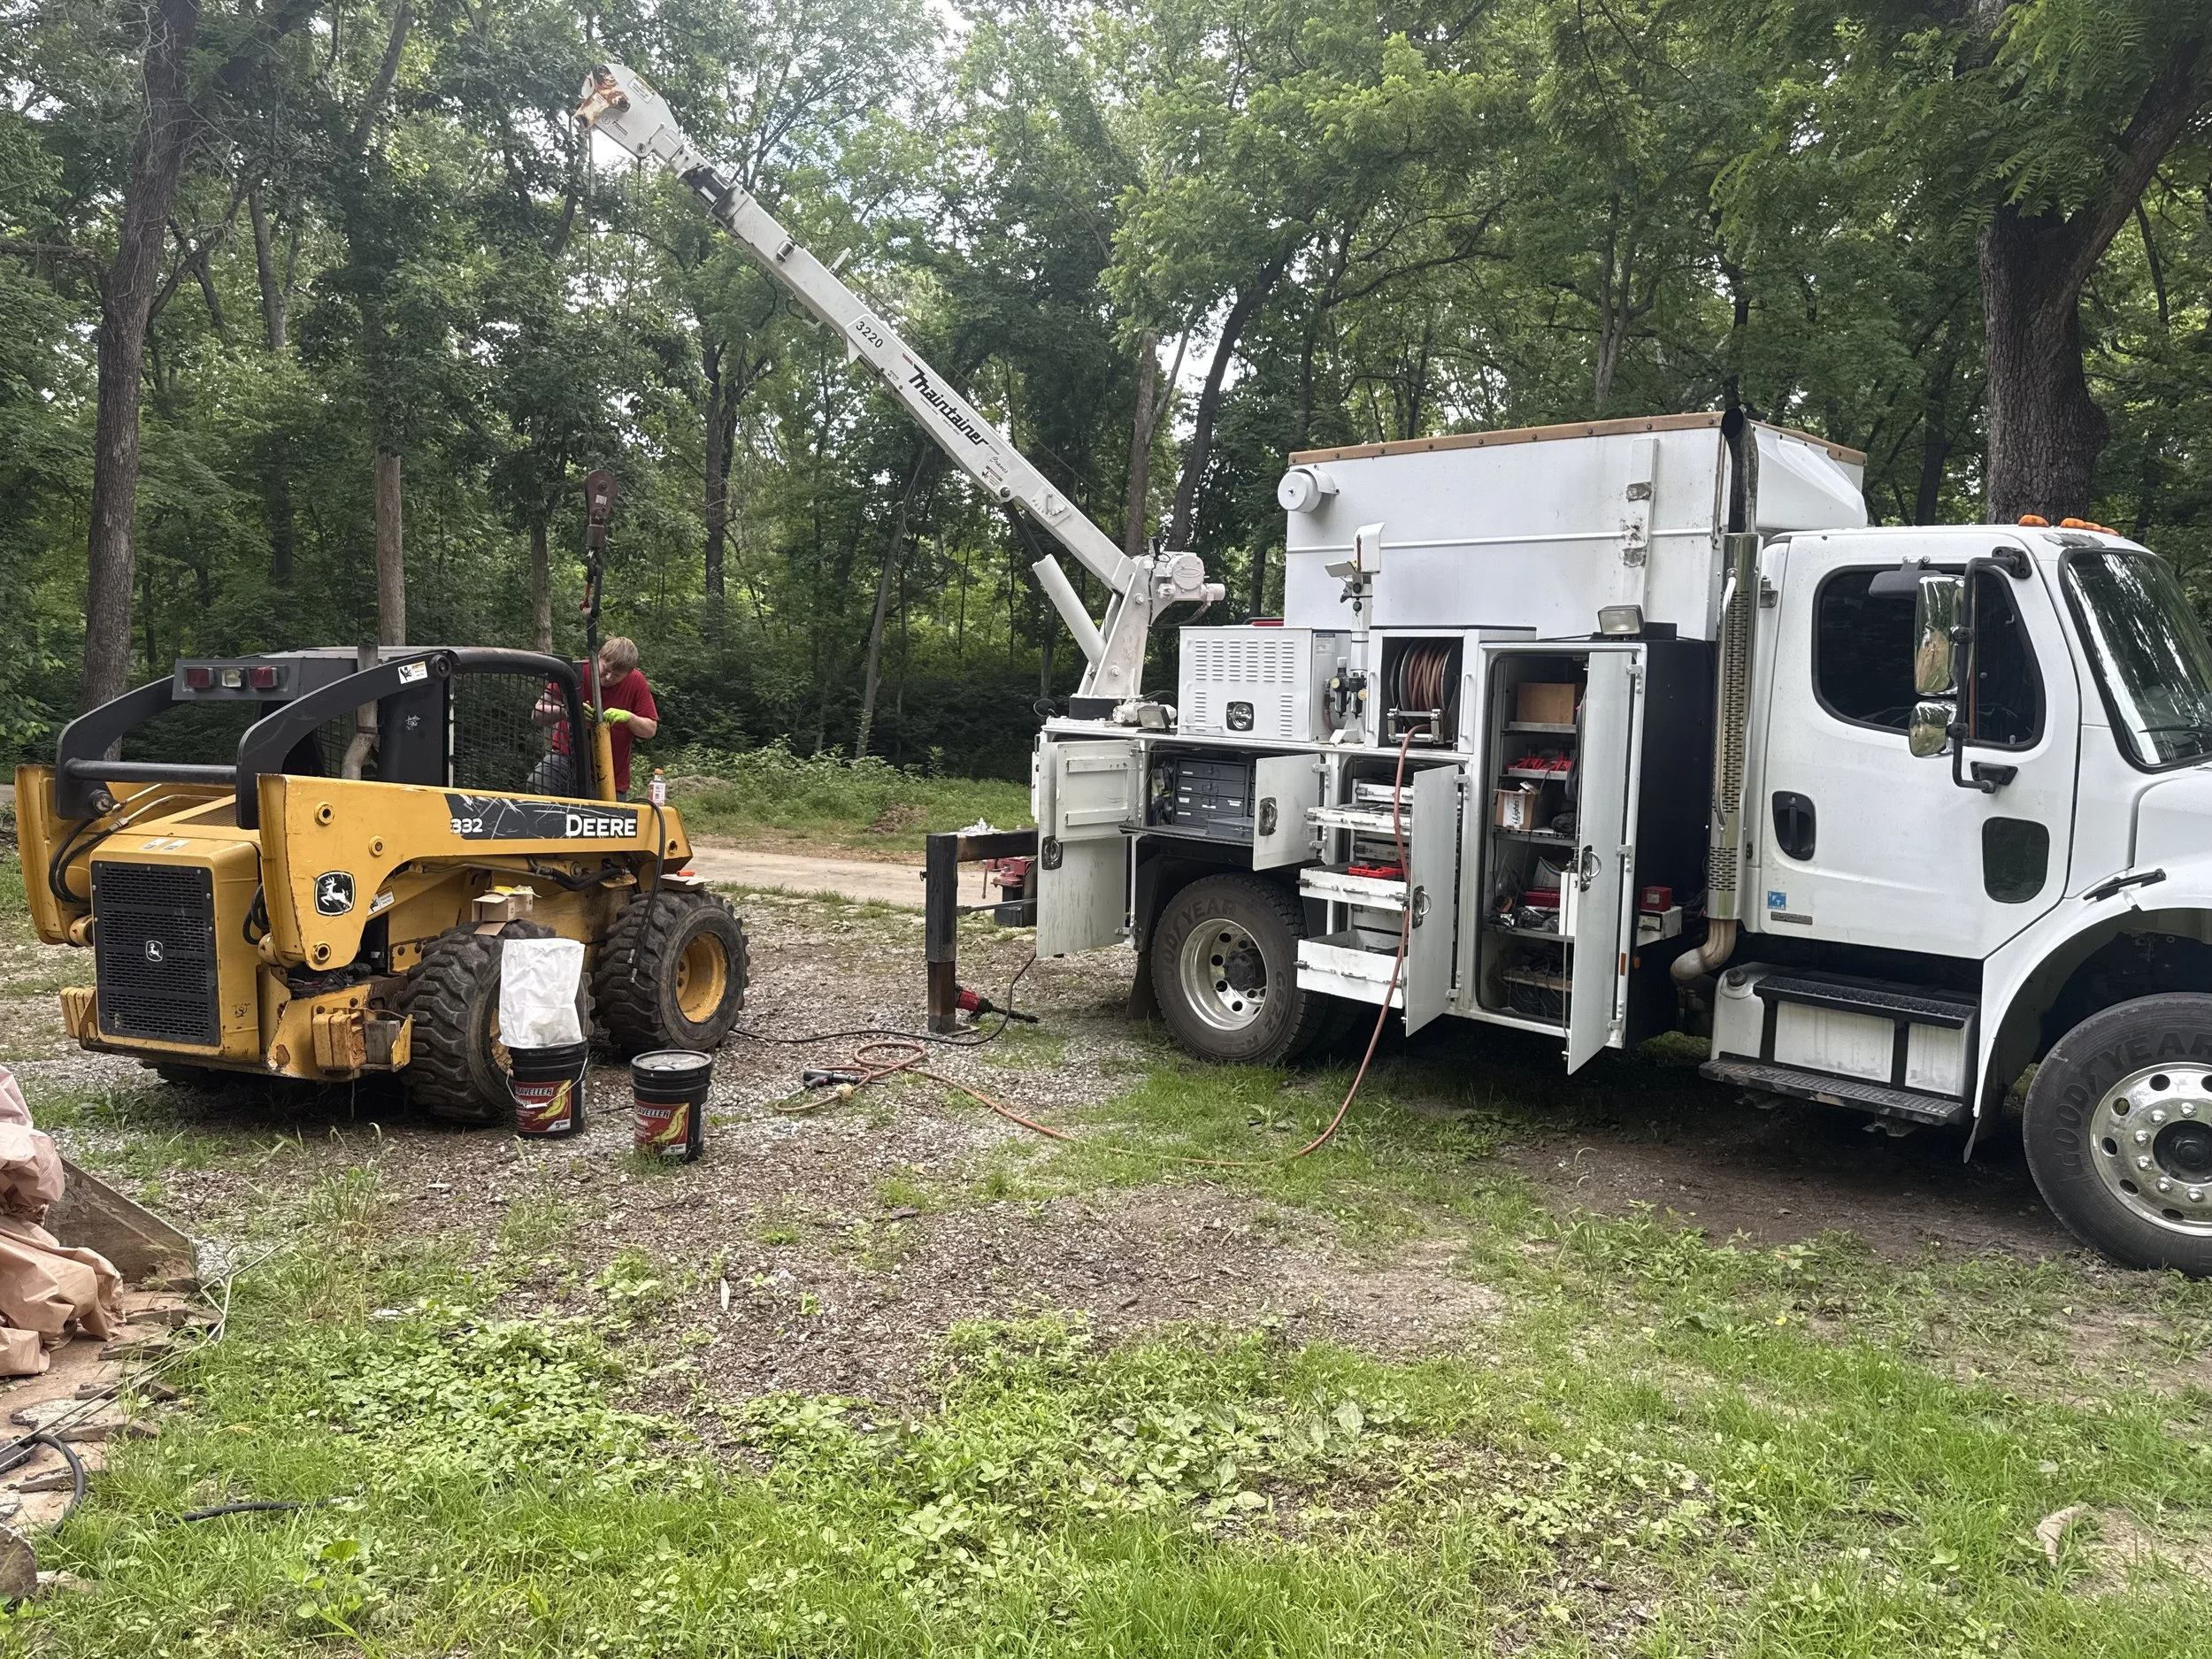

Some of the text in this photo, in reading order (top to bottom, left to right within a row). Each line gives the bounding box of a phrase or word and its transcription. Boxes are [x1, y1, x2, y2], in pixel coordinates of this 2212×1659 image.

[856, 320, 884, 349] 3220
[908, 363, 989, 446] Maintainer
[989, 456, 1009, 474] Cranes
[450, 818, 483, 833] 332
[566, 814, 636, 836] DEERE
[1263, 970, 1283, 1032] G622
